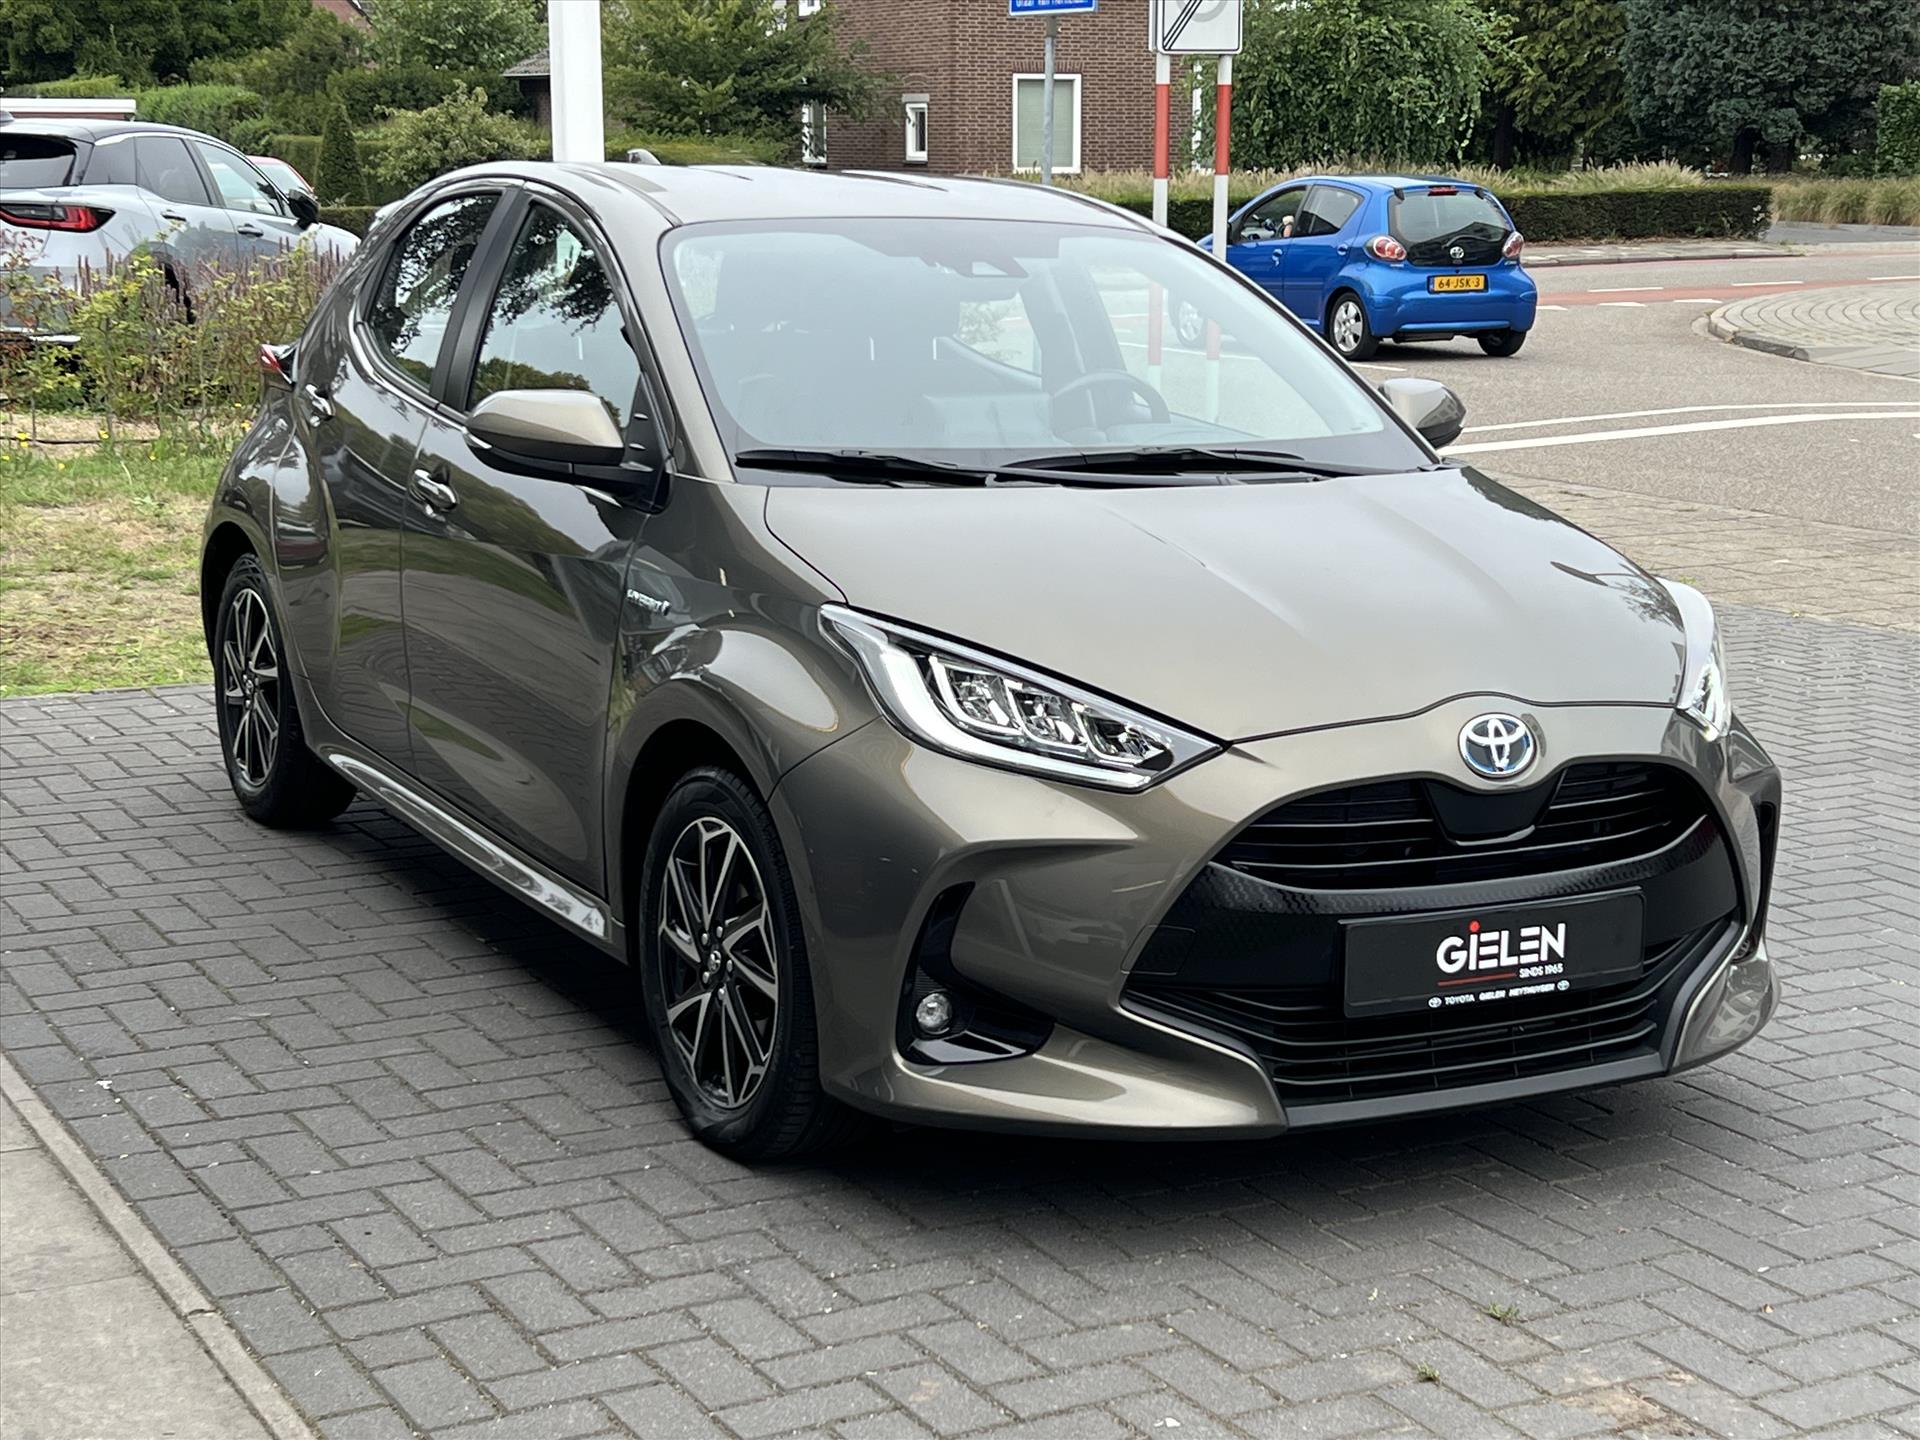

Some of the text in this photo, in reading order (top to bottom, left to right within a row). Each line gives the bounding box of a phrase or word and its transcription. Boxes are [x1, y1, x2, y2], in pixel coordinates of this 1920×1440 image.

[1519, 963, 1564, 979] SINDS 1965
[1444, 994, 1475, 1005] TOYOTA
